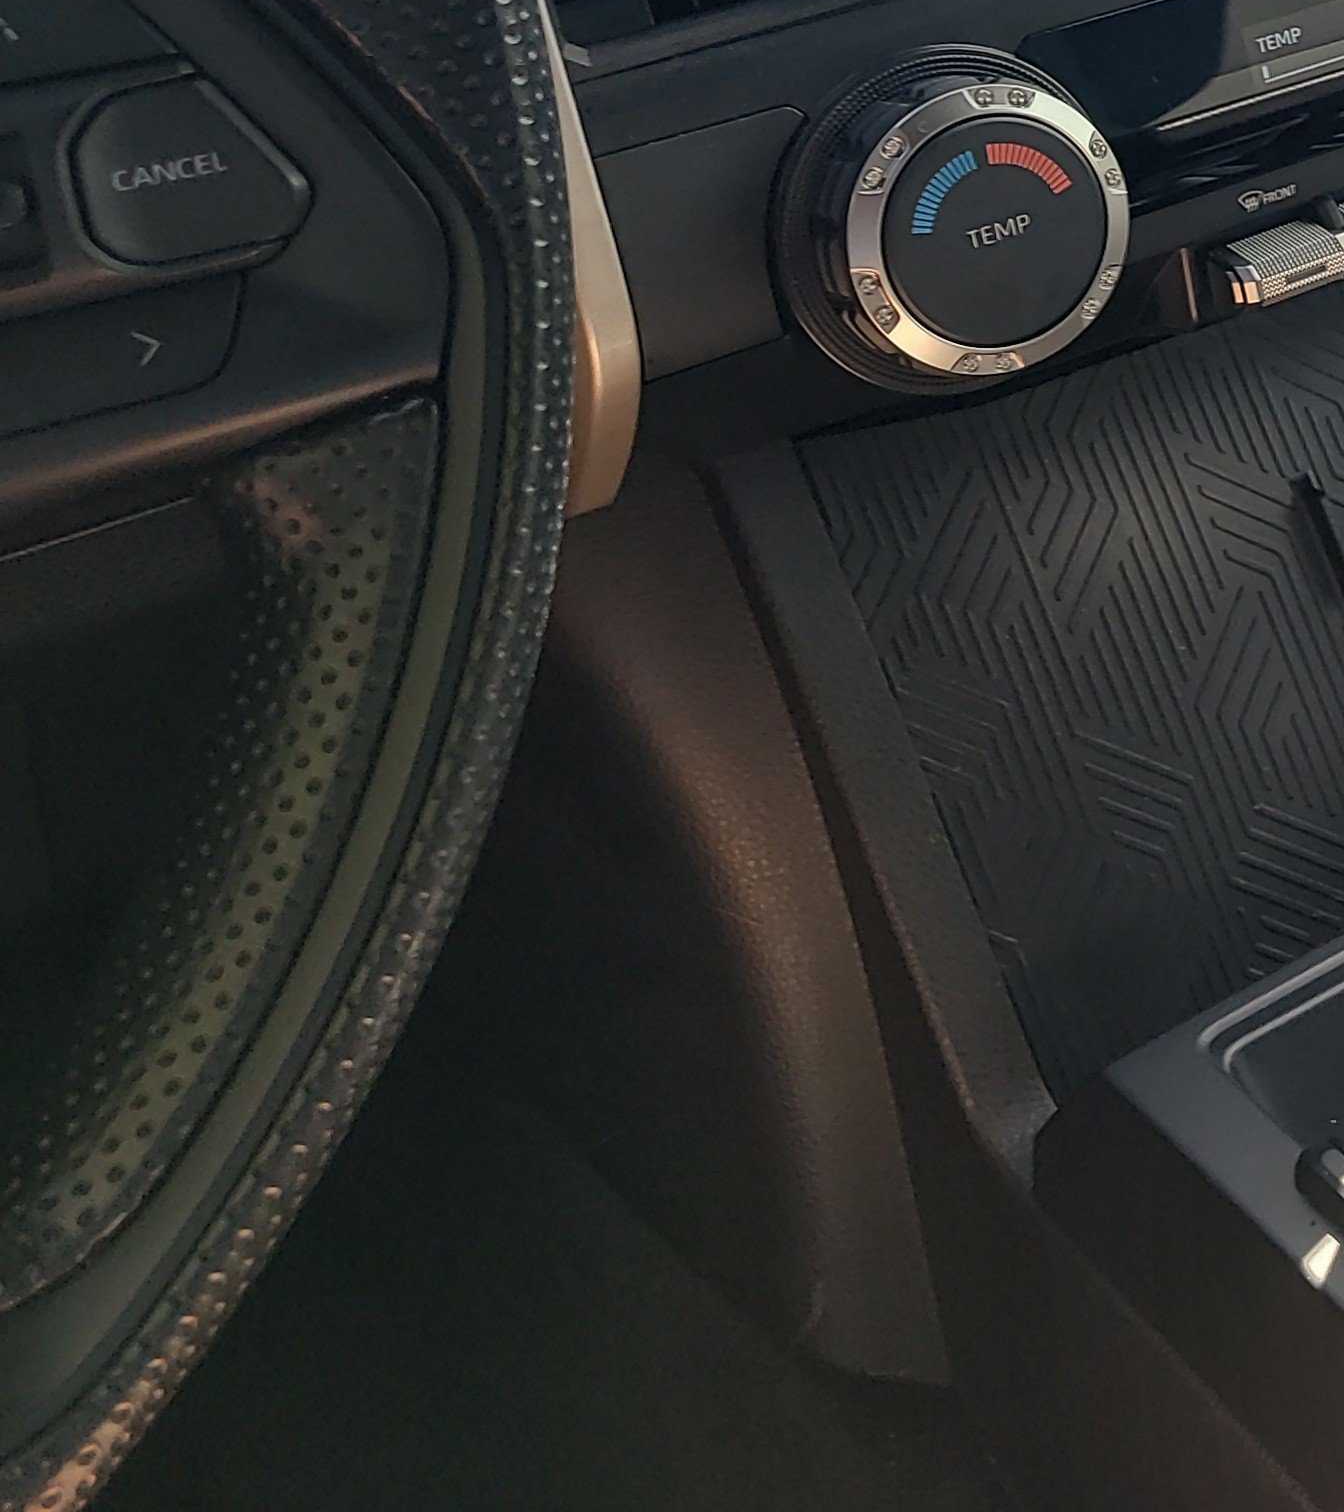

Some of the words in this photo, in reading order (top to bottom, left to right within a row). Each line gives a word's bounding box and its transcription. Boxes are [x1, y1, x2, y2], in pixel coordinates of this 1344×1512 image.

[1255, 26, 1303, 53] TEMP
[110, 152, 228, 192] CANCEL
[1263, 183, 1297, 206] FRONT
[966, 212, 1033, 250] TEMP
